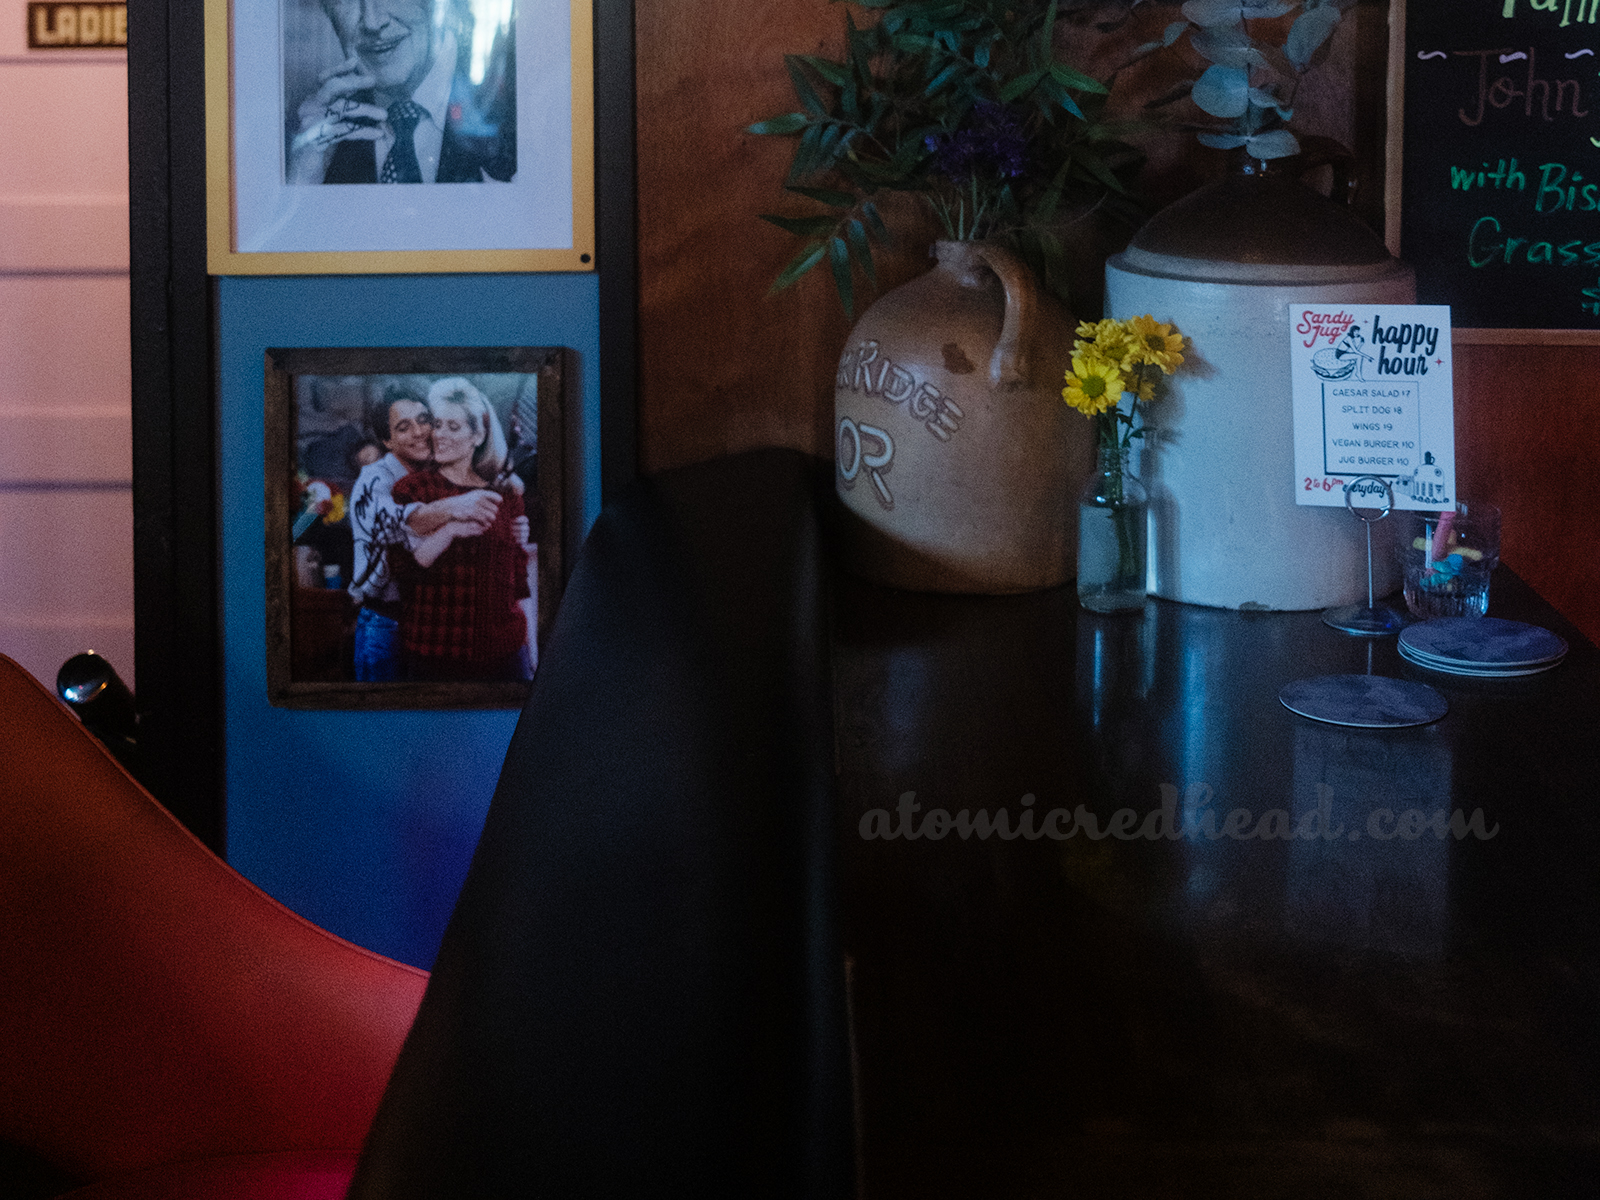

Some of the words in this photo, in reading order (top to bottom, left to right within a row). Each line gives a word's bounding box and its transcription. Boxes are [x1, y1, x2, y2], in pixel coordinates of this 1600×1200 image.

[1453, 46, 1589, 126] John
[1450, 158, 1526, 191] with
[1535, 162, 1600, 213] Bis
[1296, 310, 1355, 334] Sandy
[1303, 325, 1342, 348] Jug
[1371, 314, 1439, 357] happy
[1378, 345, 1428, 376] hour
[1332, 388, 1369, 397] CAESAR
[1370, 389, 1400, 398] SALAD
[1341, 405, 1369, 414] SPLIT
[1372, 405, 1391, 414] DOG
[1352, 422, 1380, 431] WINGS
[1332, 438, 1361, 447] VEGAN
[1363, 439, 1399, 448] BURGER
[1338, 456, 1355, 464] JUG
[1358, 456, 1394, 465] BURGER
[1304, 477, 1312, 491] 2
